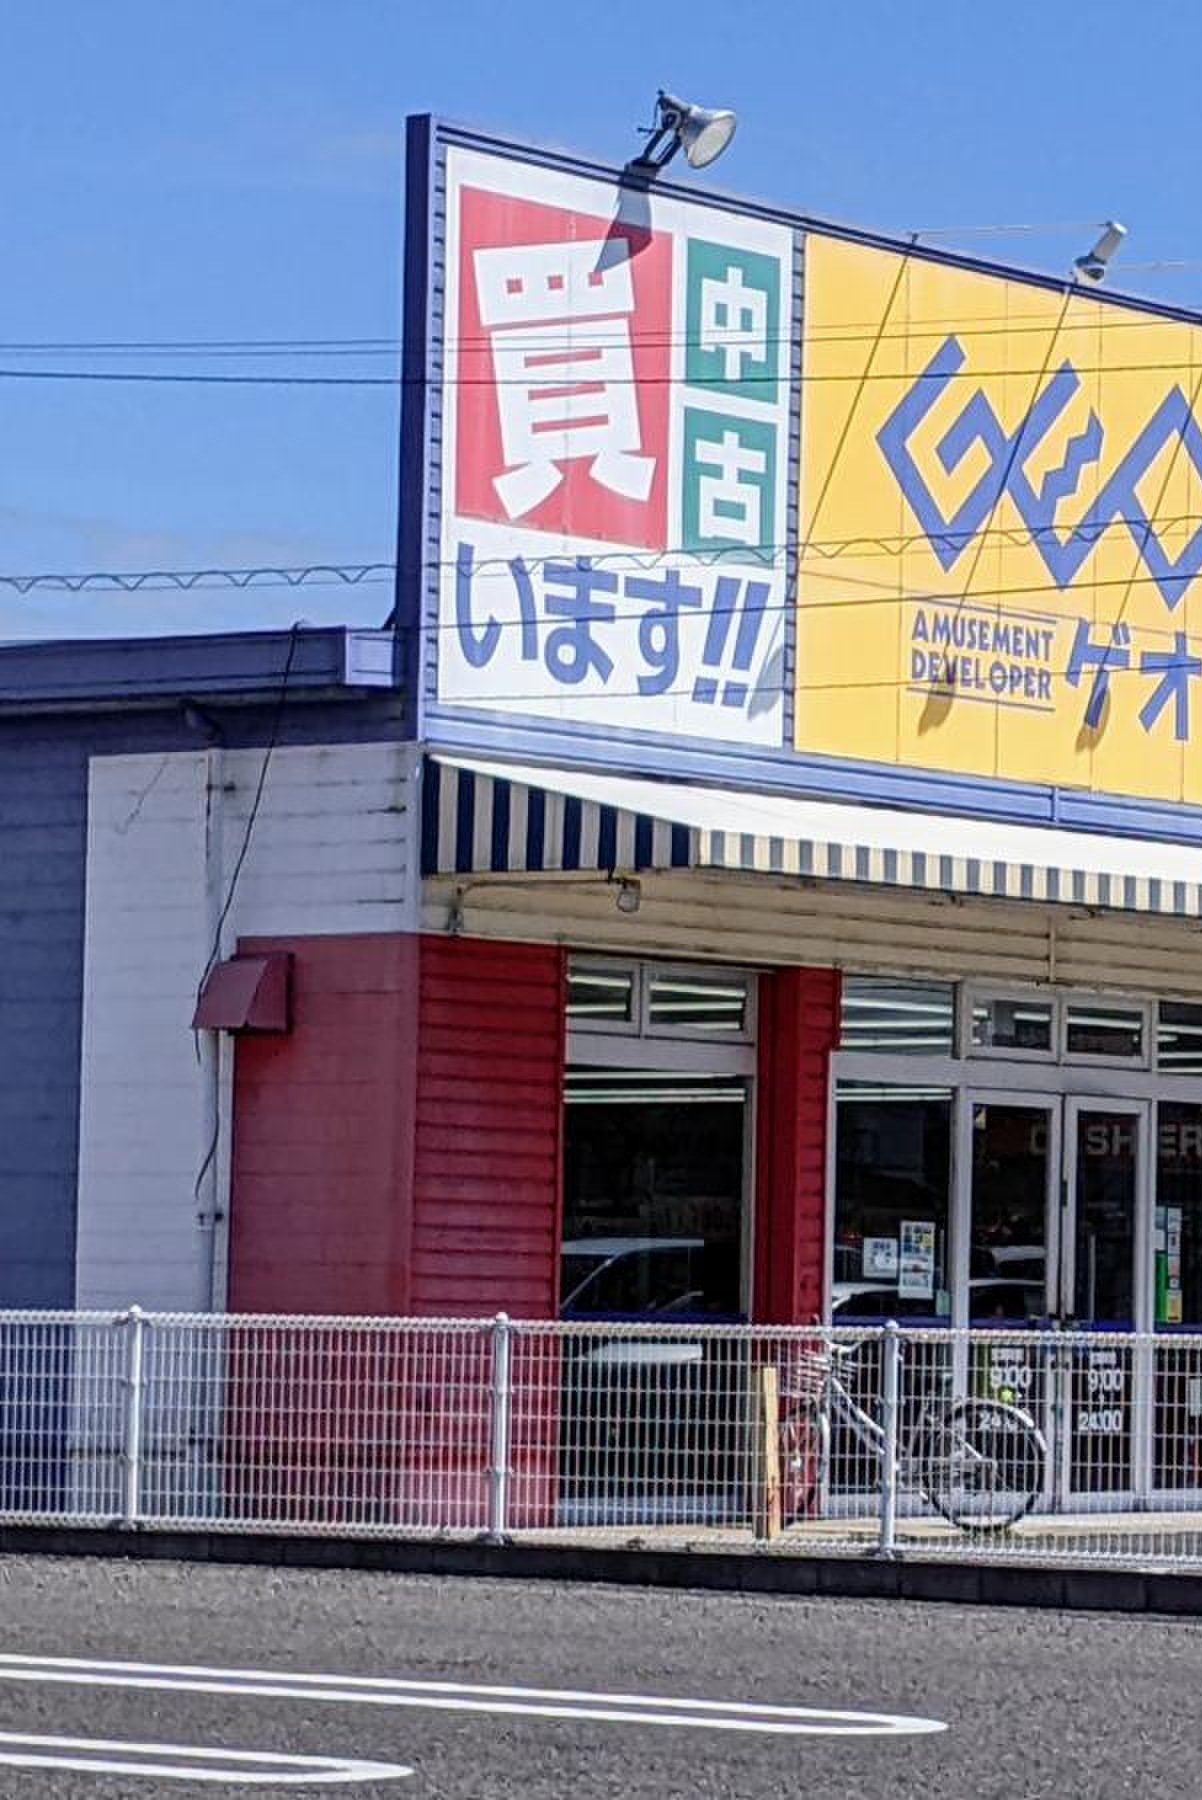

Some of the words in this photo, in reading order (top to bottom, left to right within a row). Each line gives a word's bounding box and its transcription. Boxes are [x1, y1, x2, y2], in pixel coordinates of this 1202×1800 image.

[473, 237, 656, 521] 買
[694, 265, 769, 546] 中古
[911, 609, 1054, 661] AMUSEMENT
[911, 649, 1051, 698] DEVELOPER
[1066, 618, 1202, 740] ゲオ
